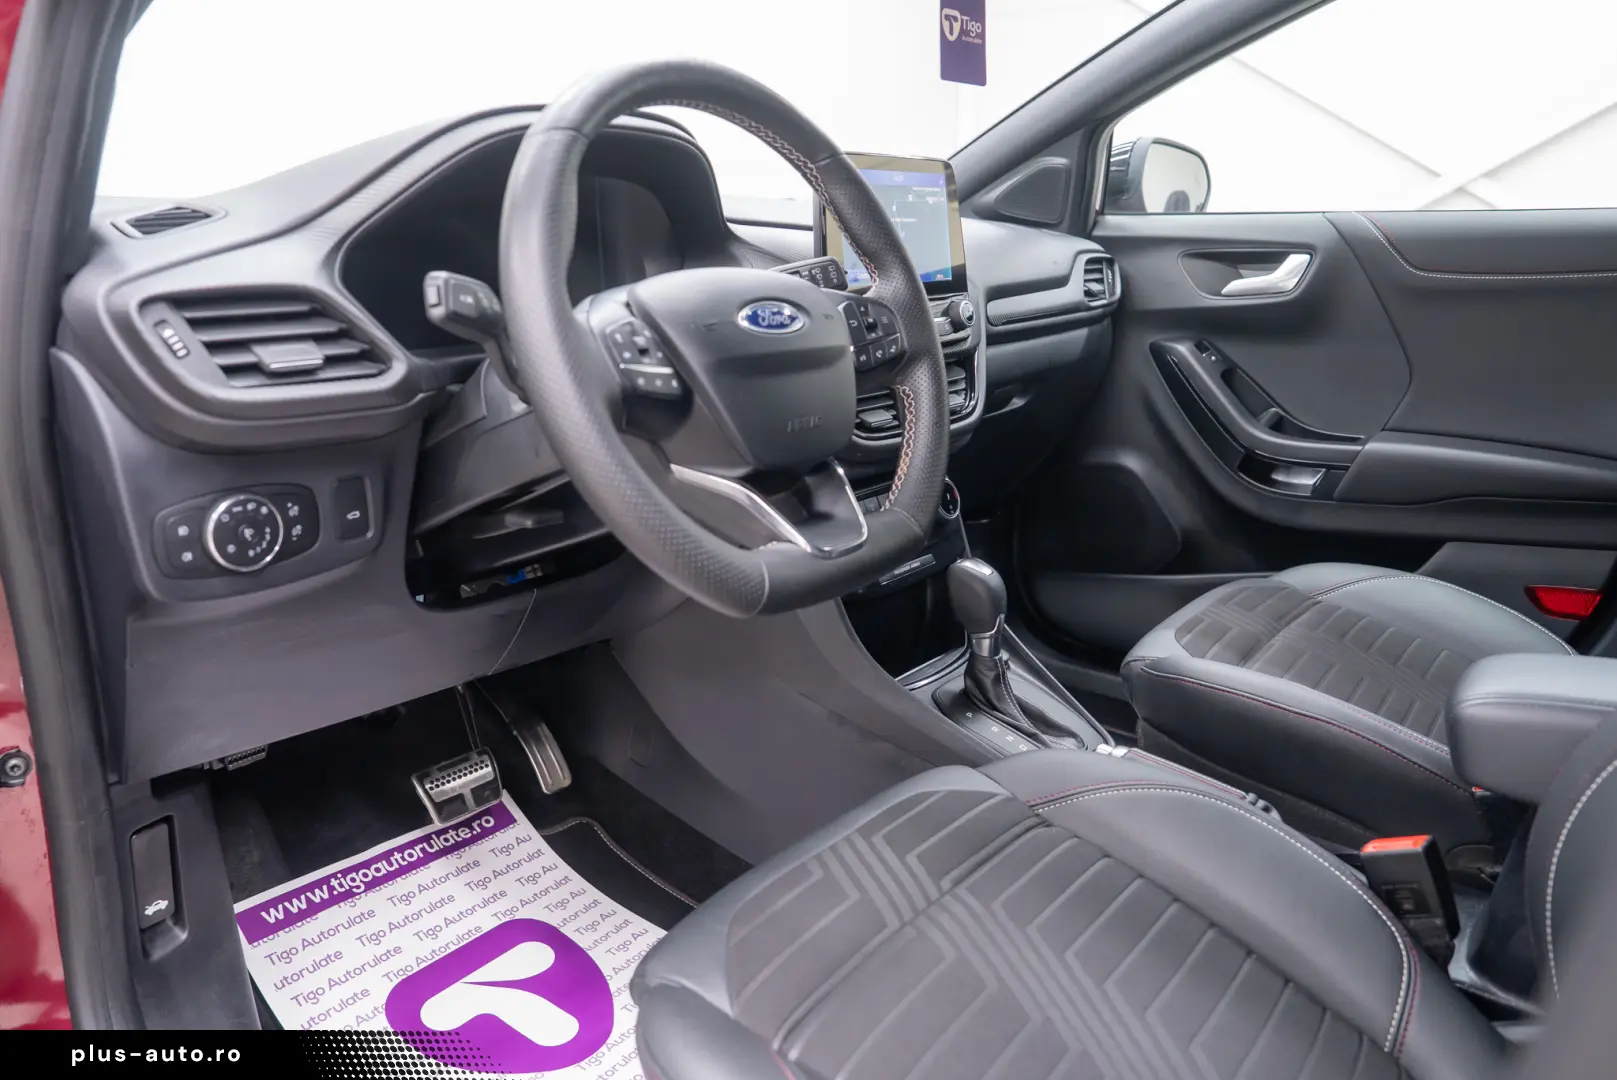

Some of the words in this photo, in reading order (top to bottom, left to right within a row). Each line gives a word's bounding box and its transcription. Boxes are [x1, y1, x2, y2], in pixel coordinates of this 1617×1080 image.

[961, 15, 982, 37] Tigo
[757, 307, 793, 327] Ford
[260, 815, 495, 924] www.tigoautorulate.ro
[264, 945, 299, 967] Tigo
[300, 909, 377, 951] Autorulate
[386, 889, 416, 907] Tigo
[417, 858, 481, 895] Autorulate
[488, 841, 515, 858] Tigo
[515, 833, 532, 847] Au
[355, 929, 387, 948] Tigo
[388, 893, 456, 934] Autorulate
[464, 874, 492, 892] Tigo
[493, 847, 545, 881] Autorulat
[543, 897, 570, 914] Tigo
[570, 887, 587, 900] Au
[381, 964, 414, 984] Tigo
[415, 924, 484, 967] Autorulate
[491, 905, 519, 921] Tigo
[520, 874, 573, 909] Autorulat
[556, 897, 603, 930] utorulat
[573, 919, 600, 936] Tigo
[600, 908, 617, 922] Au
[290, 986, 326, 1008] Tigo
[327, 945, 403, 991] Autorulate
[412, 923, 443, 943] Tigo
[443, 889, 508, 929] Autorulate
[515, 870, 541, 887] Tigo
[542, 862, 558, 876] Au
[605, 940, 632, 956] Tigo
[632, 927, 649, 941] Au
[574, 1050, 605, 1071] Tigo
